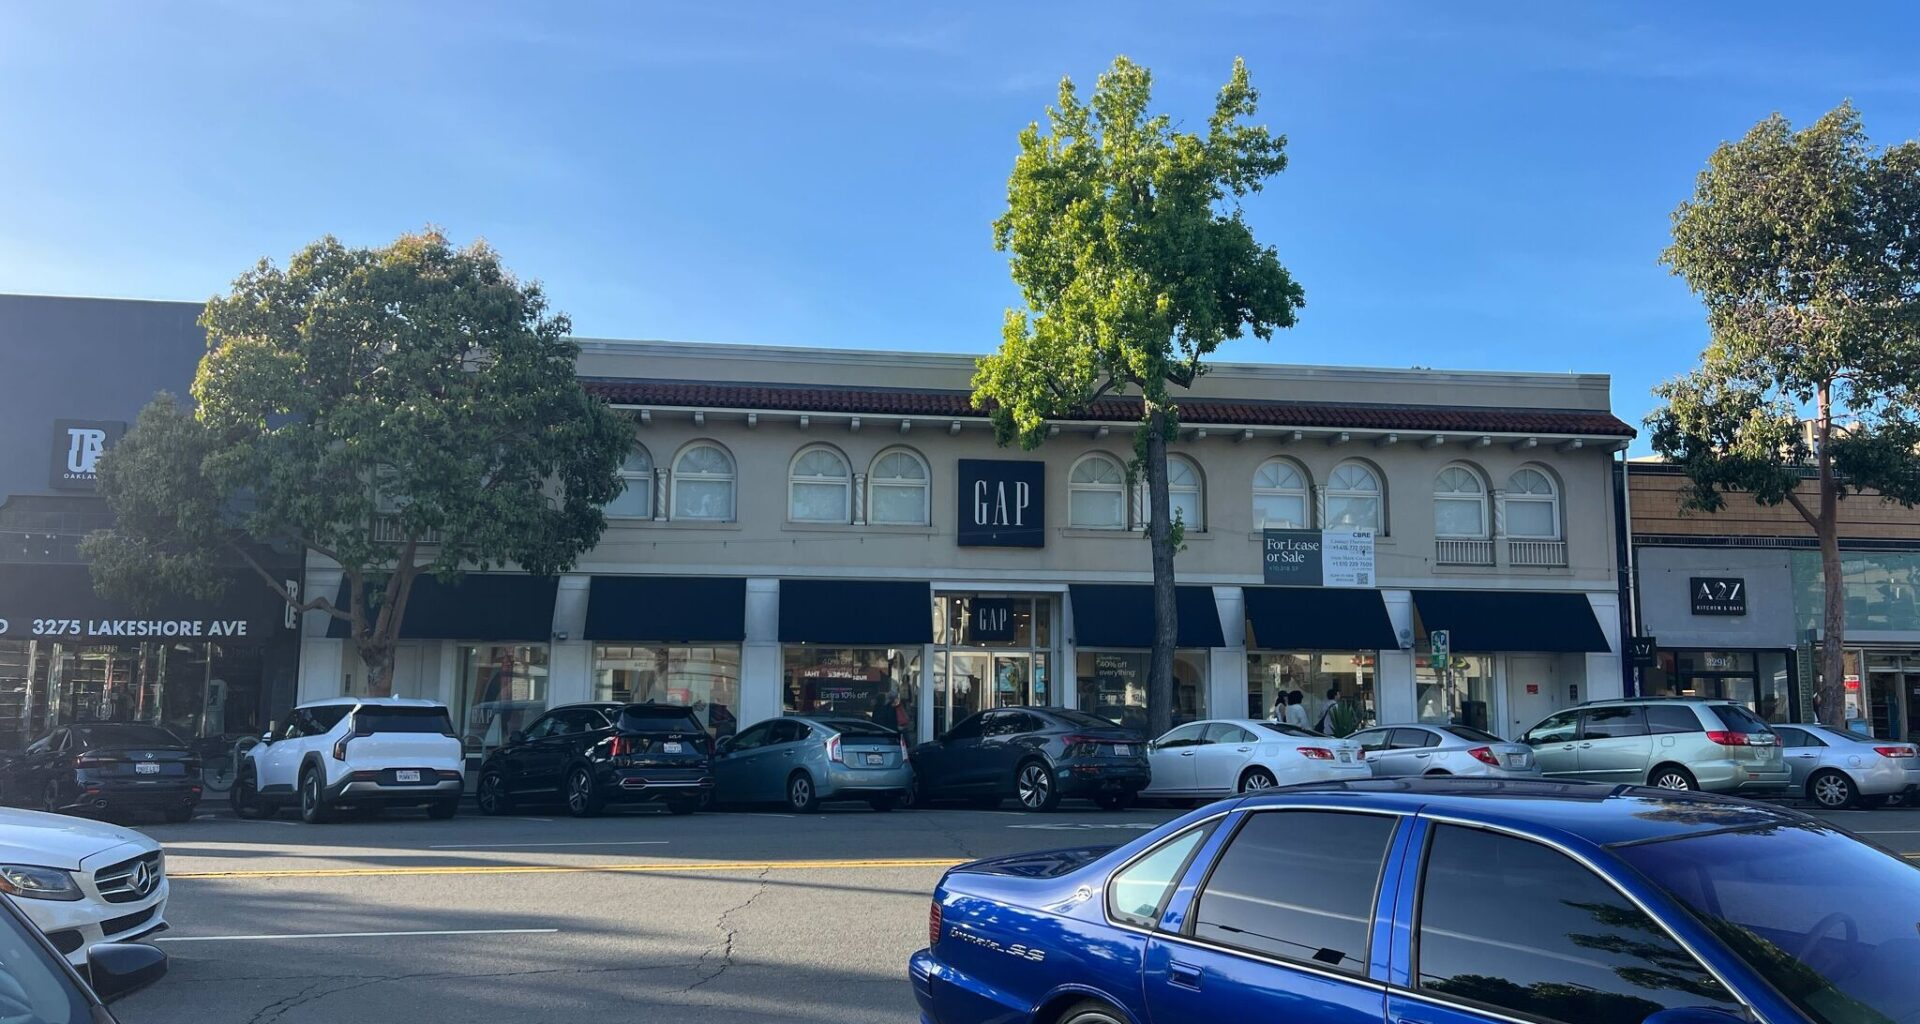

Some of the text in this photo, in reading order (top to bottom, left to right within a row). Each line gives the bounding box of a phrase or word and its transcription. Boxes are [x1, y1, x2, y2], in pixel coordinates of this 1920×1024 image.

[974, 479, 1030, 526] GAP
[1267, 539, 1319, 551] For Lease
[1266, 550, 1305, 563] or Sale
[32, 619, 247, 637] 3275 LAKESHORE AVE
[979, 608, 1007, 631] GAP
